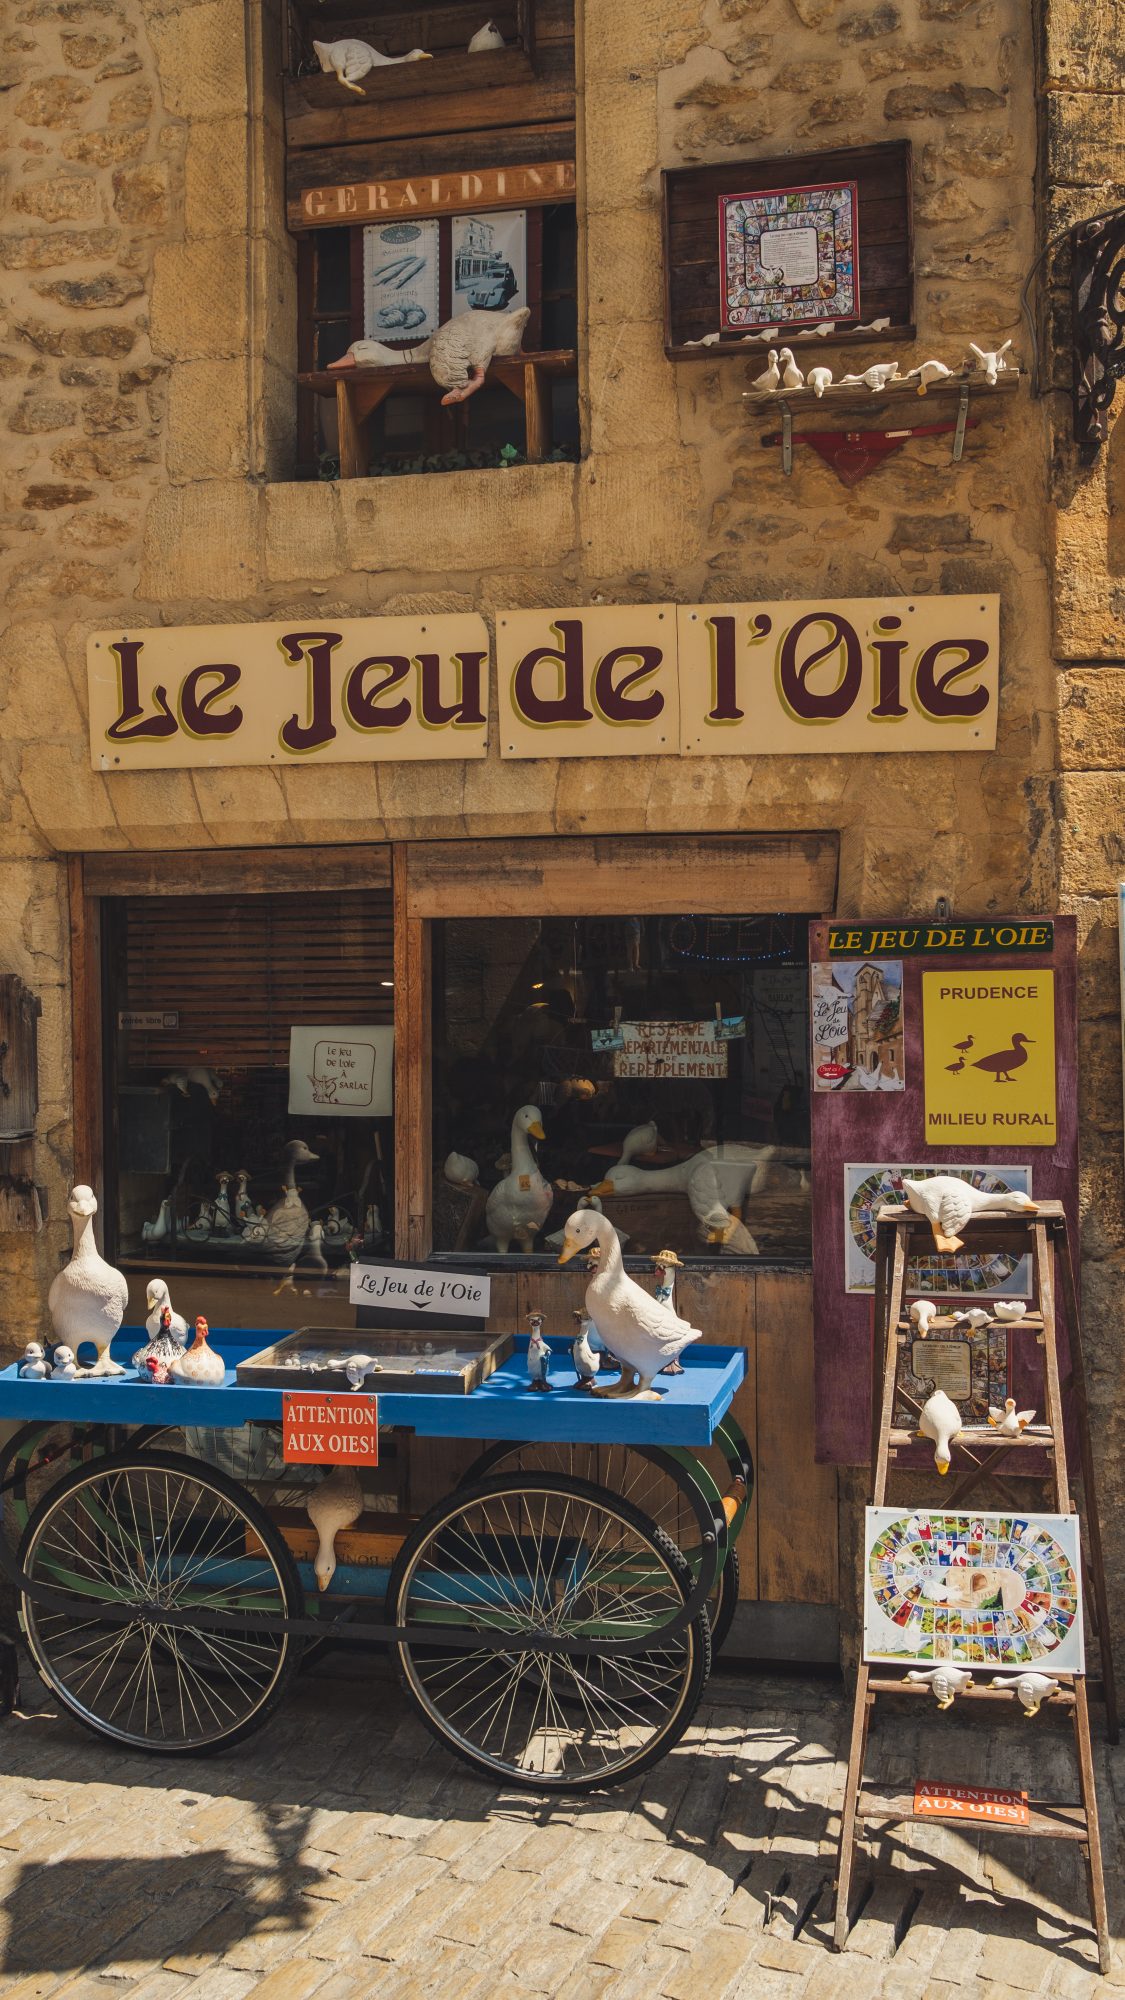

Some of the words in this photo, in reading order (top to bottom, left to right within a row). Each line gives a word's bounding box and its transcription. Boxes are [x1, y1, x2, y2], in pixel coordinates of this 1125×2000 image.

[305, 163, 576, 217] GERALDINE
[105, 641, 244, 744] Le
[277, 631, 489, 755] Jeu
[510, 619, 665, 730] de
[704, 611, 990, 726] l'Oie
[829, 932, 862, 950] LE
[863, 930, 919, 954] JEU
[924, 929, 966, 948] DE
[972, 927, 1048, 946] L'OIE
[940, 986, 1038, 999] PRUDENCE
[928, 1113, 986, 1125] MILIEU
[992, 1113, 1054, 1125] RURAL
[357, 1274, 377, 1293] Le
[376, 1276, 408, 1296] Jeu
[414, 1279, 434, 1296] de
[440, 1281, 482, 1301] l'Oie
[287, 1405, 375, 1424] ATTENTION
[287, 1433, 325, 1452] AUX
[328, 1434, 375, 1454] OIES!
[920, 1785, 1025, 1805] ATTENTION
[918, 1798, 964, 1811] AUX
[968, 1802, 1026, 1820] OIES!
